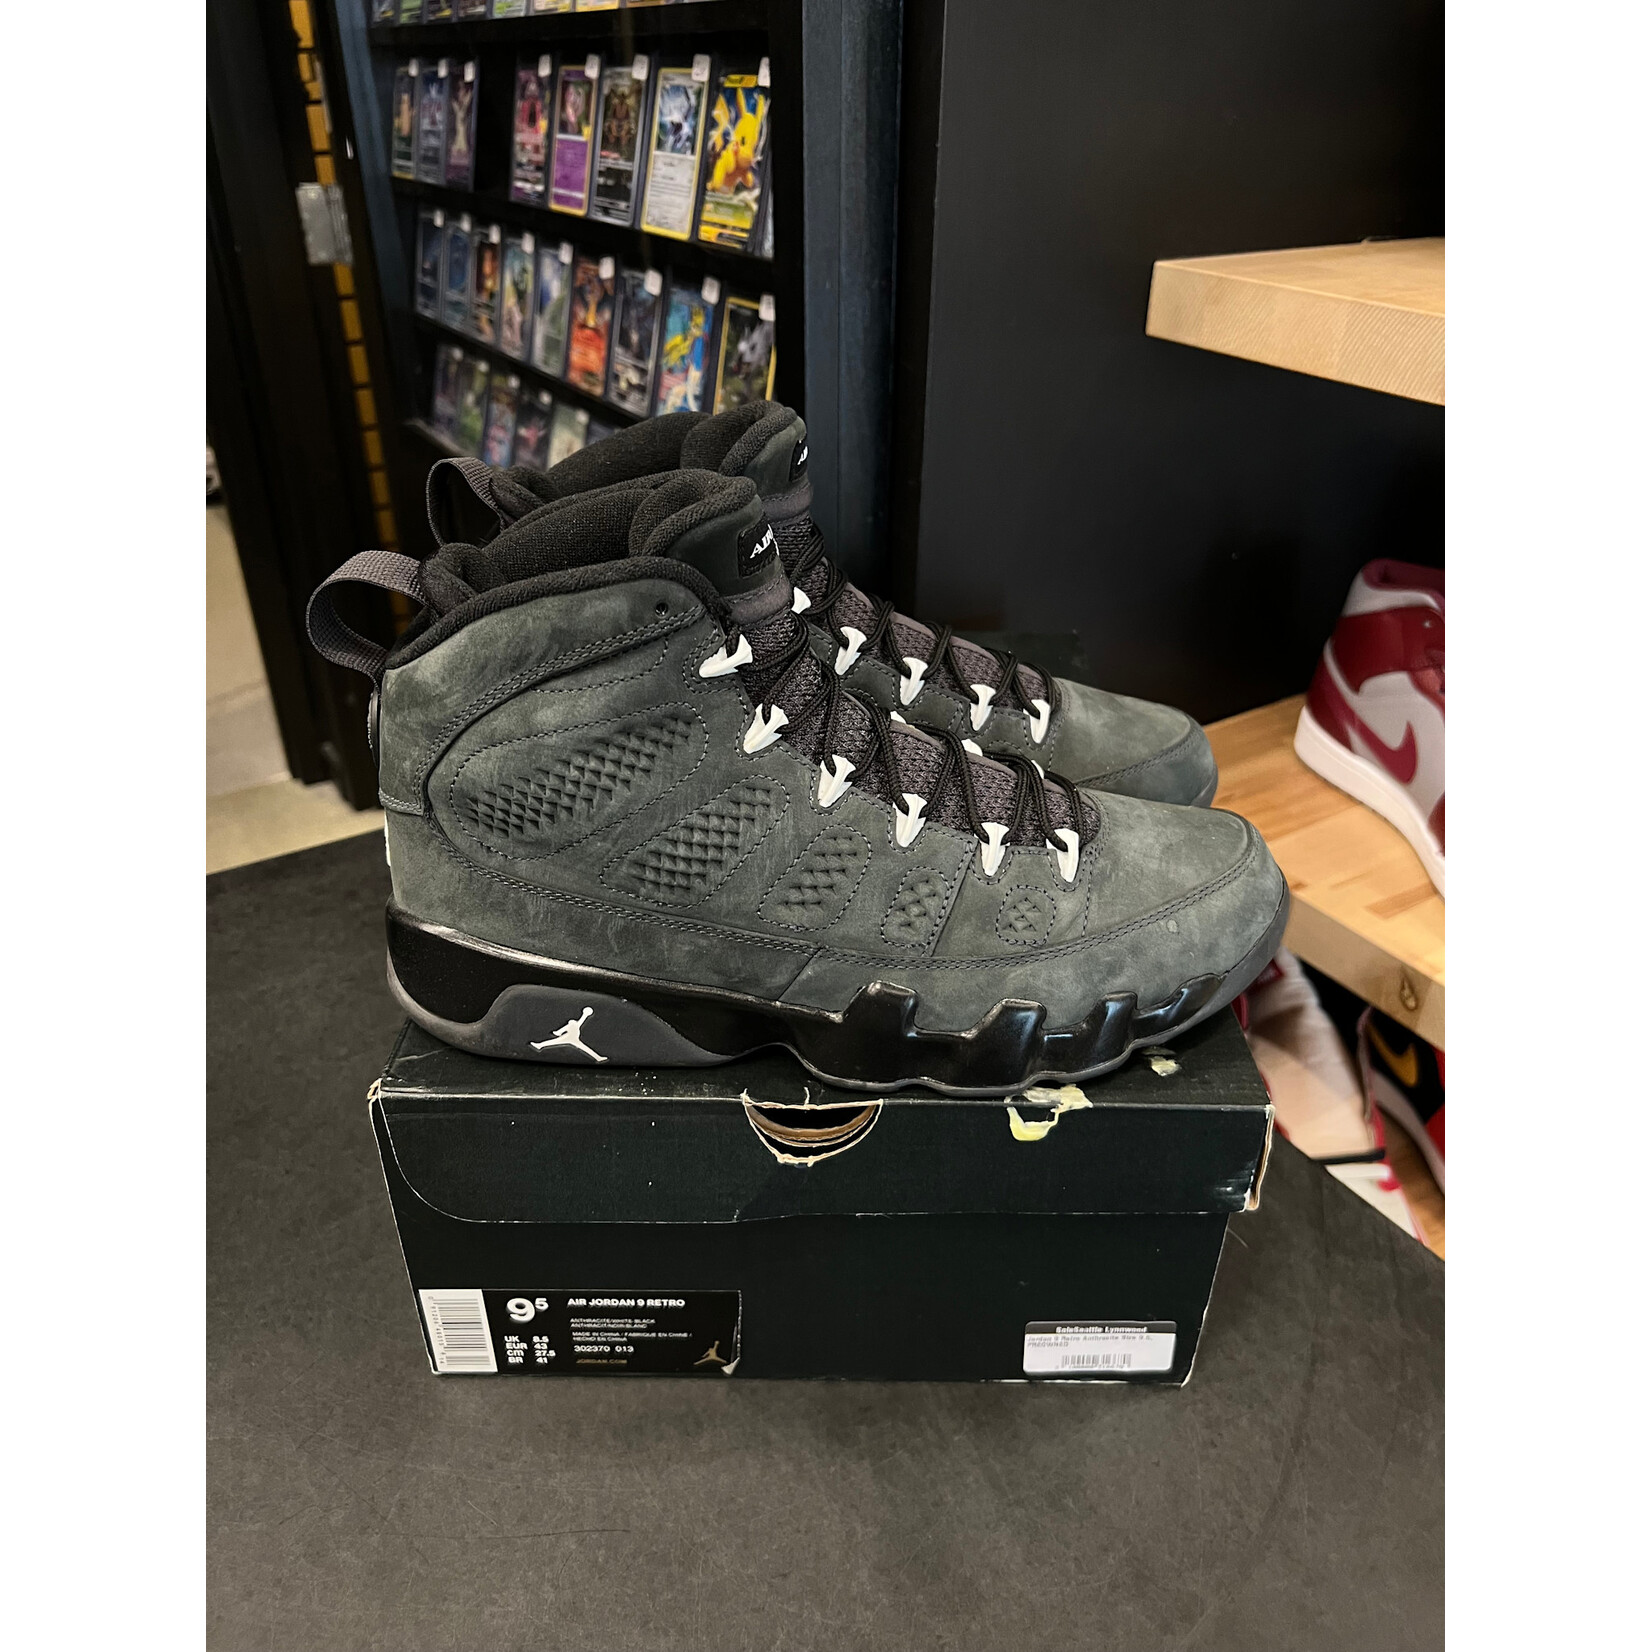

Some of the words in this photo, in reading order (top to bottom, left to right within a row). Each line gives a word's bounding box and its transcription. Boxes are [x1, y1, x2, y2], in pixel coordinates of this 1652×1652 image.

[567, 1298, 587, 1306] AIR
[588, 1299, 635, 1307] JORDAN
[636, 1299, 645, 1307] 9
[646, 1299, 686, 1307] RETRO
[504, 1335, 520, 1343] UK
[532, 1335, 549, 1343] 8.5
[505, 1342, 528, 1350] EUR
[533, 1342, 548, 1350] 43
[534, 1349, 556, 1357] 27.5
[508, 1356, 524, 1364] BR
[536, 1356, 548, 1364] 41
